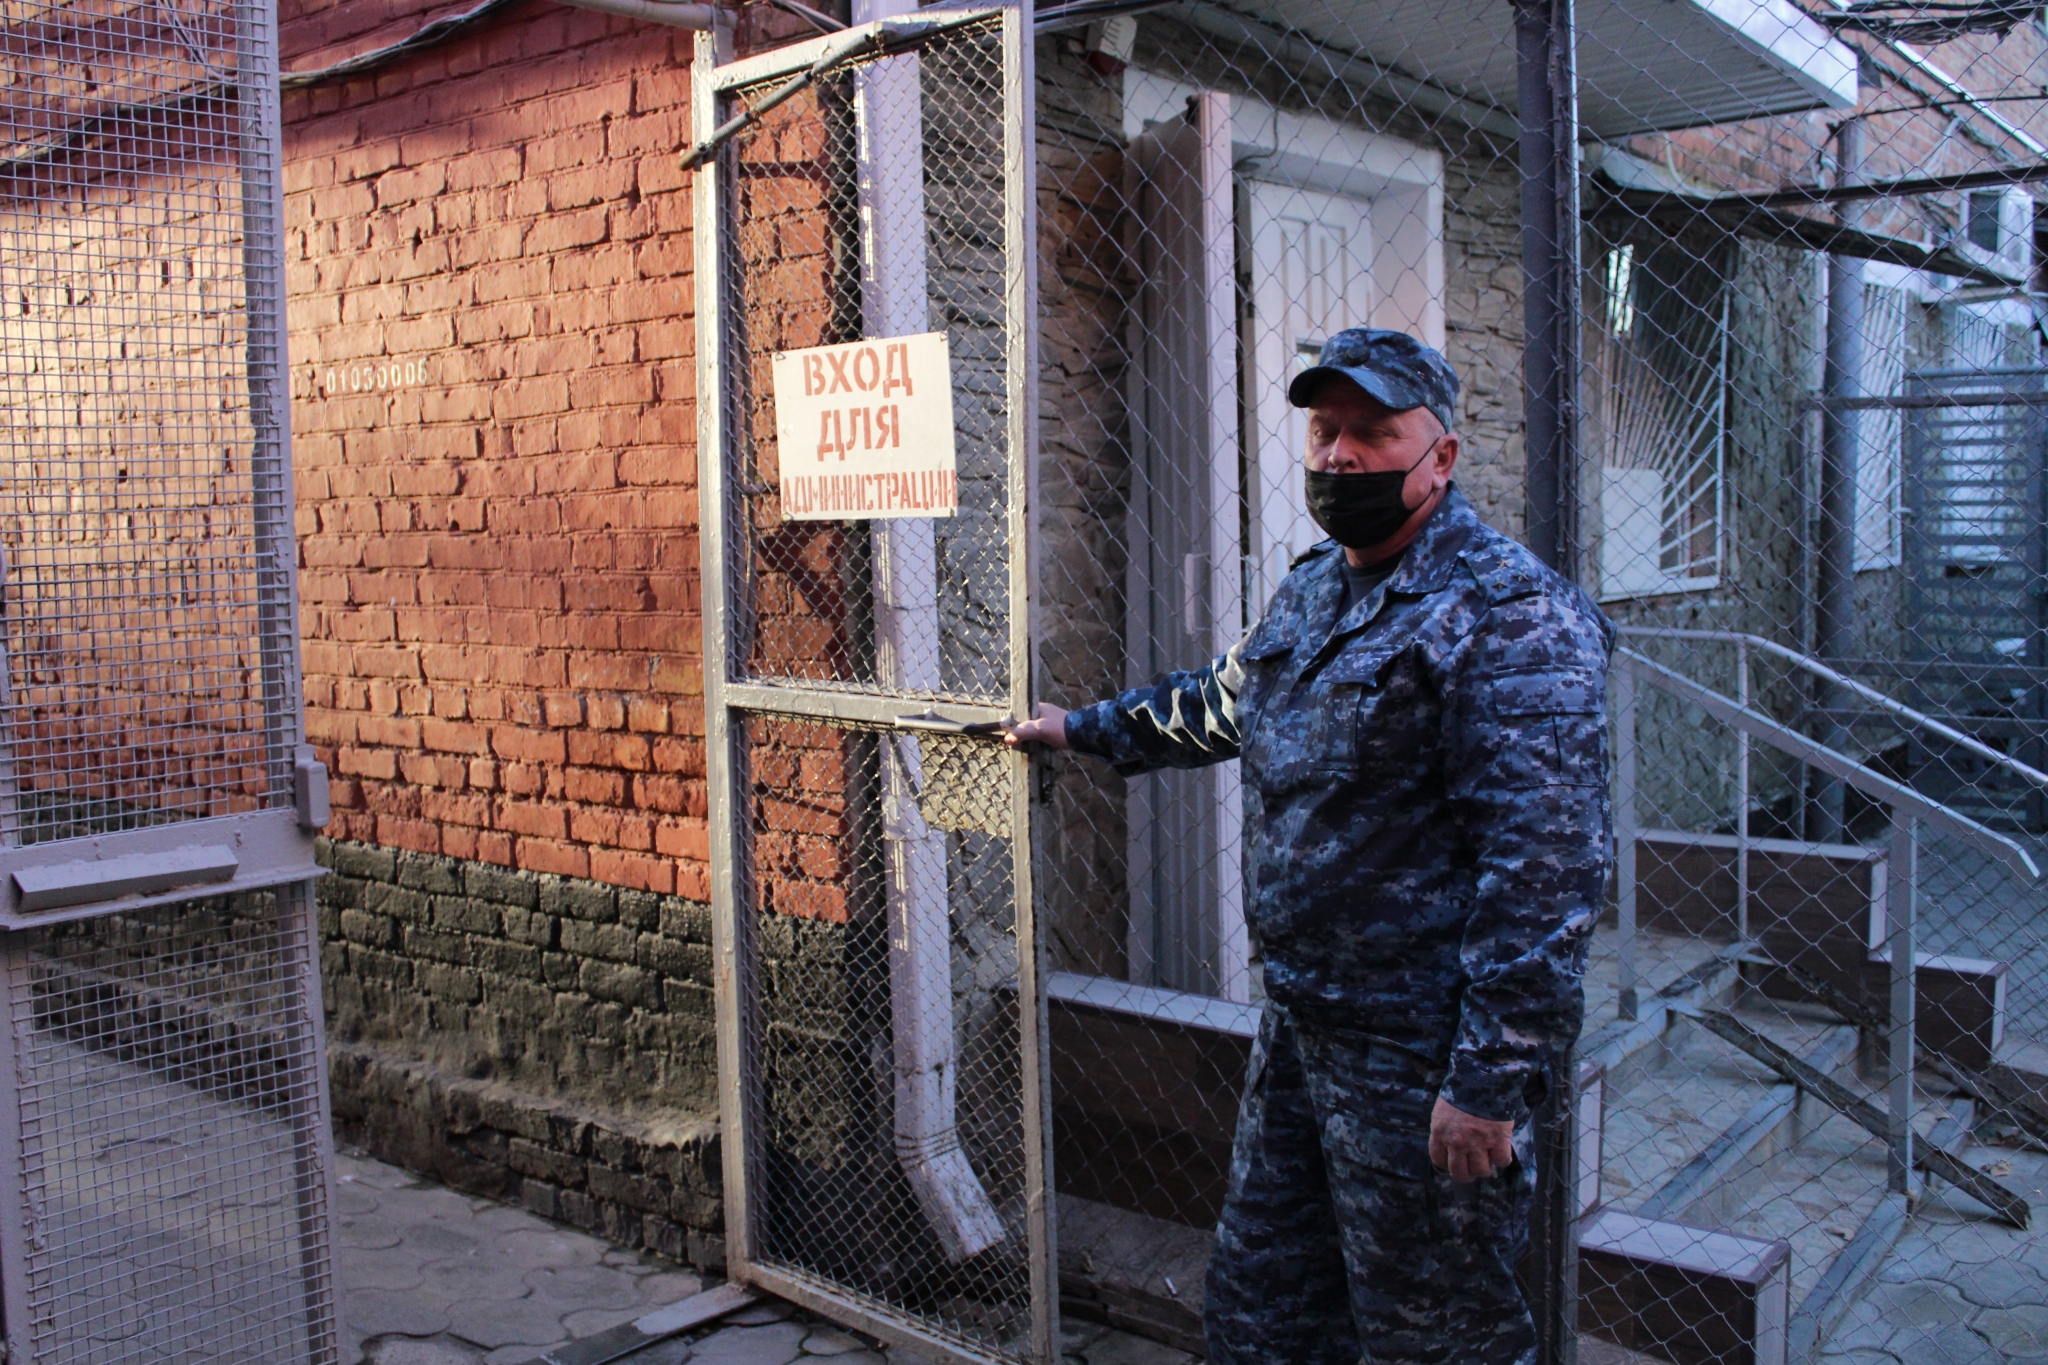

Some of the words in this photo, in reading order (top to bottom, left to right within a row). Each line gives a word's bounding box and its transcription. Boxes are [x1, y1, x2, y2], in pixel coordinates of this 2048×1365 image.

[803, 343, 913, 398] ВХОД
[817, 405, 900, 462] ДЛЯ
[782, 469, 957, 514] АДМИНИСТРАЦИИ
